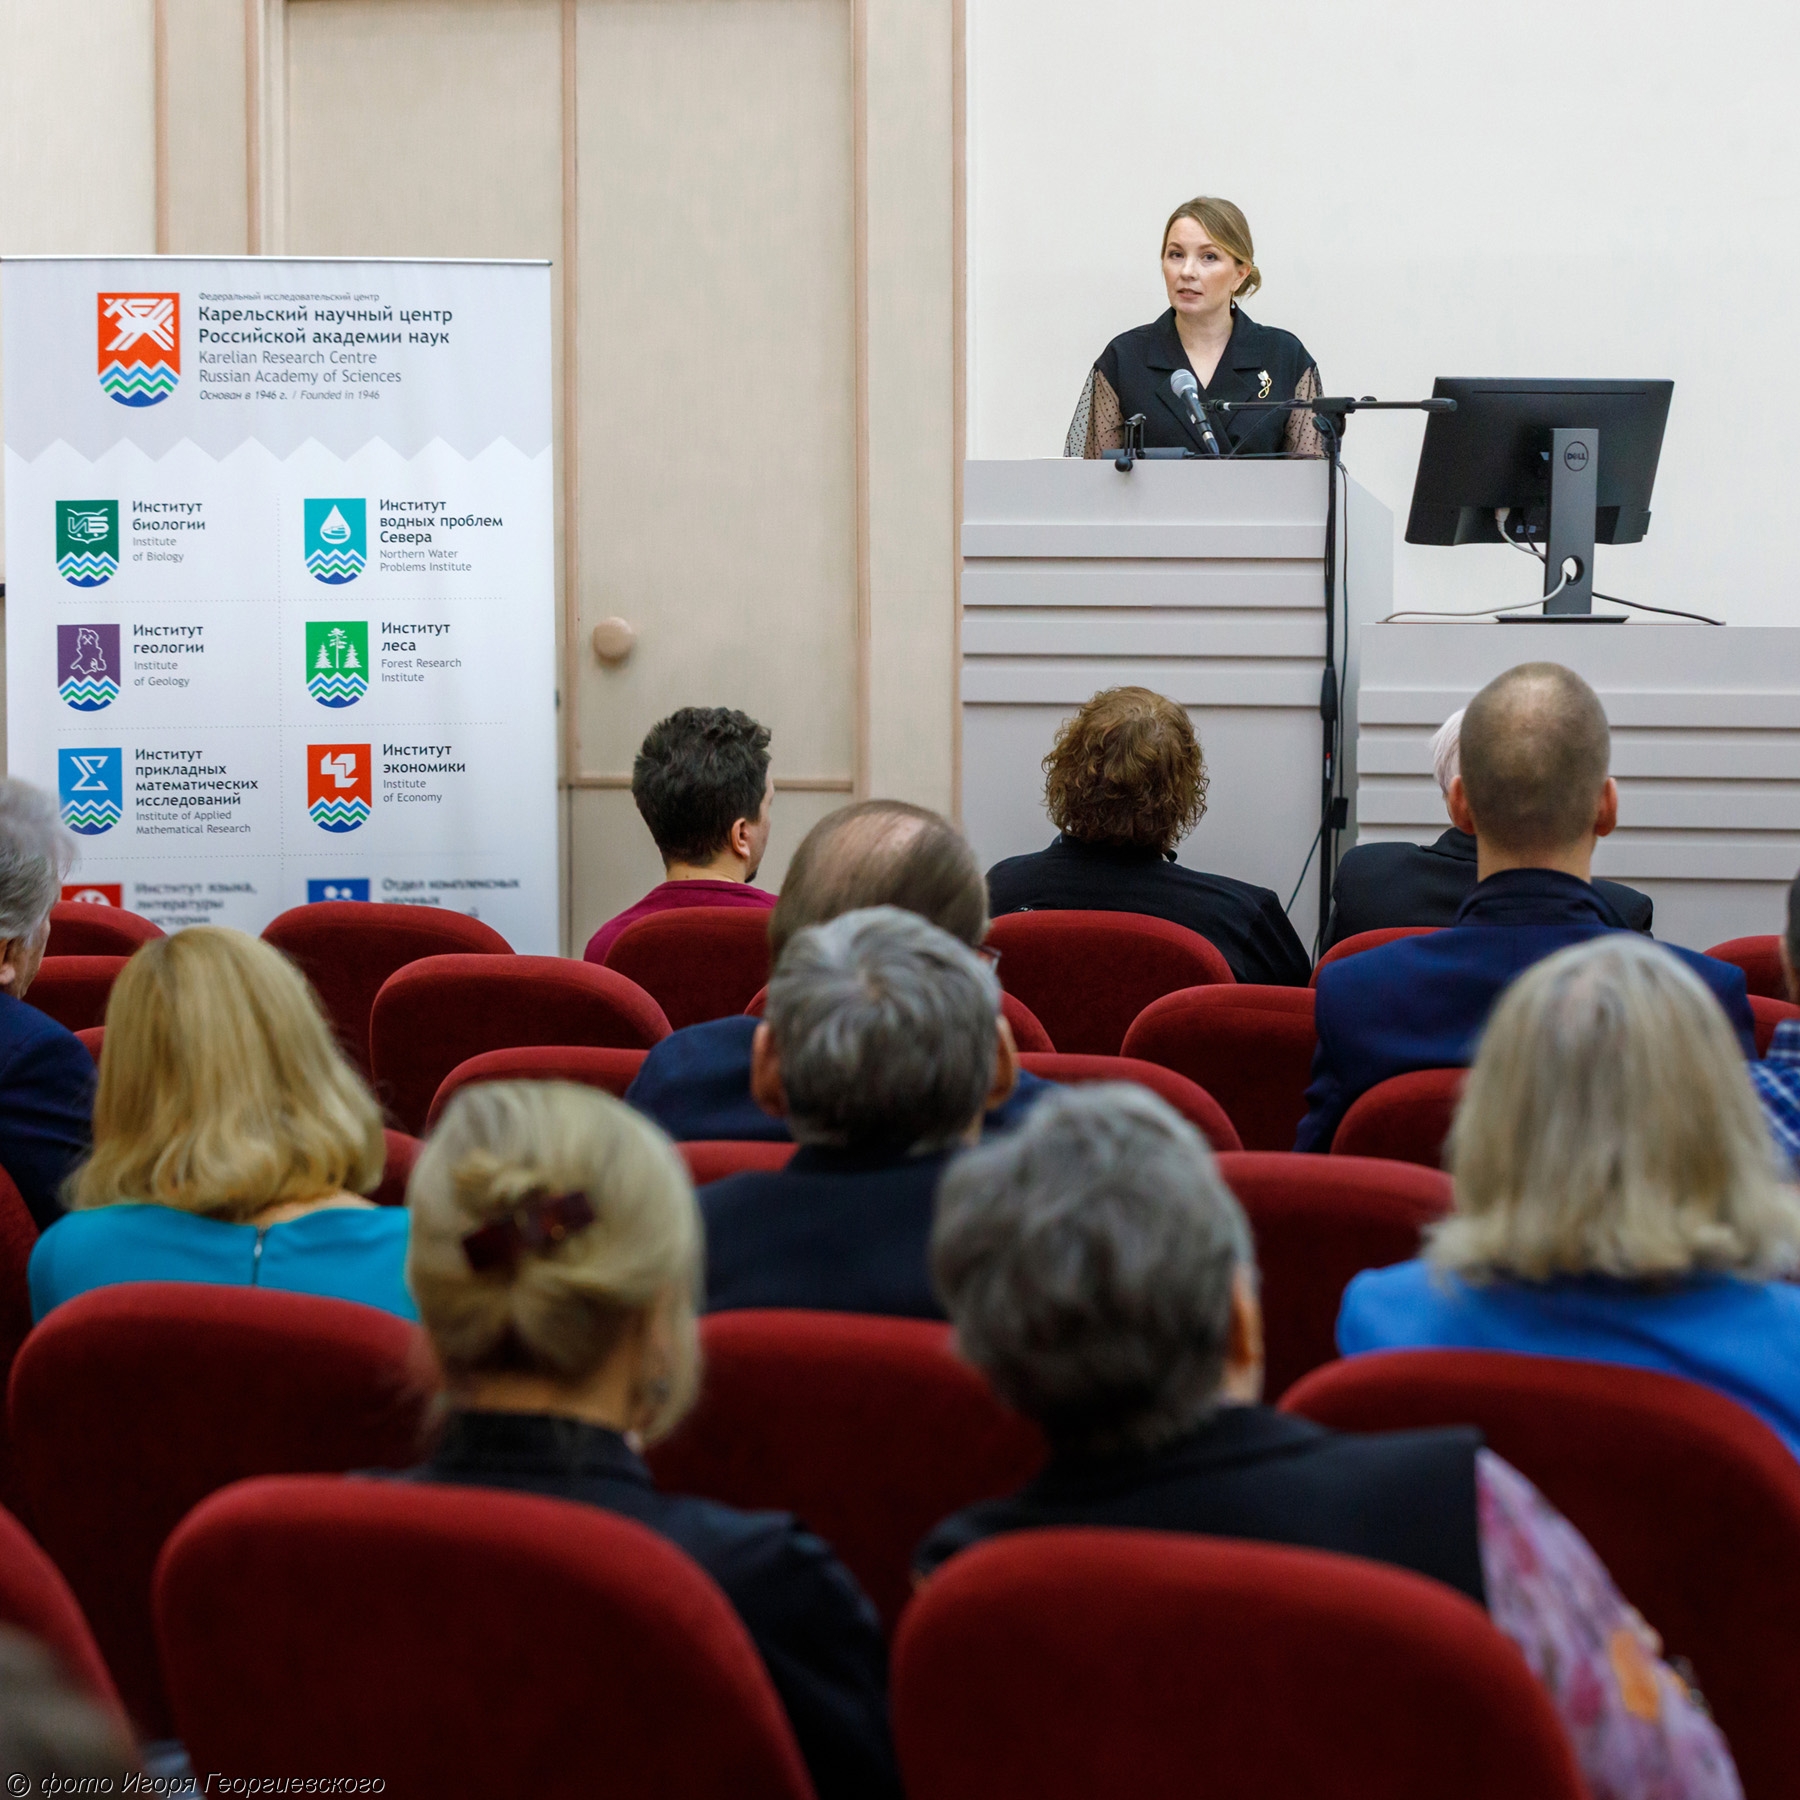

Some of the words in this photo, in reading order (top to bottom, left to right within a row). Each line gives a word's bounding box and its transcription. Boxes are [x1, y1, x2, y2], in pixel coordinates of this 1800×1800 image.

[199, 292, 261, 301] Федеральный
[354, 294, 380, 302] центр
[199, 306, 308, 324] Карельский
[315, 305, 393, 325] научный
[400, 310, 453, 325] центр
[199, 327, 306, 343] Российской
[313, 332, 401, 346] академии
[409, 332, 449, 346] наук
[199, 350, 257, 364] Karelian
[263, 350, 325, 364] Research
[330, 350, 377, 364] Centre
[199, 369, 250, 382] Russian
[255, 369, 318, 386] Academy
[323, 369, 337, 382] of
[342, 369, 402, 382] Sciences
[200, 390, 242, 400] Основан
[256, 390, 277, 400] 1946
[301, 390, 342, 400] Founded
[345, 390, 354, 400] in
[358, 390, 380, 400] 1946
[132, 500, 203, 515] Институт
[379, 499, 447, 514] Институт
[132, 518, 206, 531] биологии
[380, 517, 435, 529] водных
[440, 514, 503, 529] проблем
[132, 537, 177, 547] Institute
[380, 531, 432, 546] Севера
[132, 552, 143, 561] of
[146, 552, 184, 563] Biology
[379, 550, 425, 559] Northern
[428, 550, 458, 559] Water
[379, 563, 426, 572] Problems
[429, 563, 472, 572] Institute
[133, 624, 203, 638] Институт
[381, 622, 451, 637] Институт
[133, 643, 204, 654] геологии
[381, 640, 416, 652] леса
[134, 661, 178, 670] Institute
[381, 658, 413, 668] Forest
[416, 658, 462, 668] Research
[134, 676, 144, 686] of
[148, 676, 190, 688] Geology
[381, 673, 425, 682] Institute
[135, 748, 203, 763] Институт
[383, 744, 452, 758] Институт
[135, 765, 226, 778] прикладных
[383, 762, 466, 773] экономики
[135, 780, 258, 791] математических
[383, 779, 426, 789] Institute
[135, 792, 241, 808] исследований
[383, 793, 393, 803] of
[397, 793, 442, 804] Economy
[136, 812, 178, 821] Institute
[181, 811, 192, 820] of
[194, 811, 232, 822] Applied
[136, 824, 203, 834] Mathematical
[207, 824, 251, 834] Research
